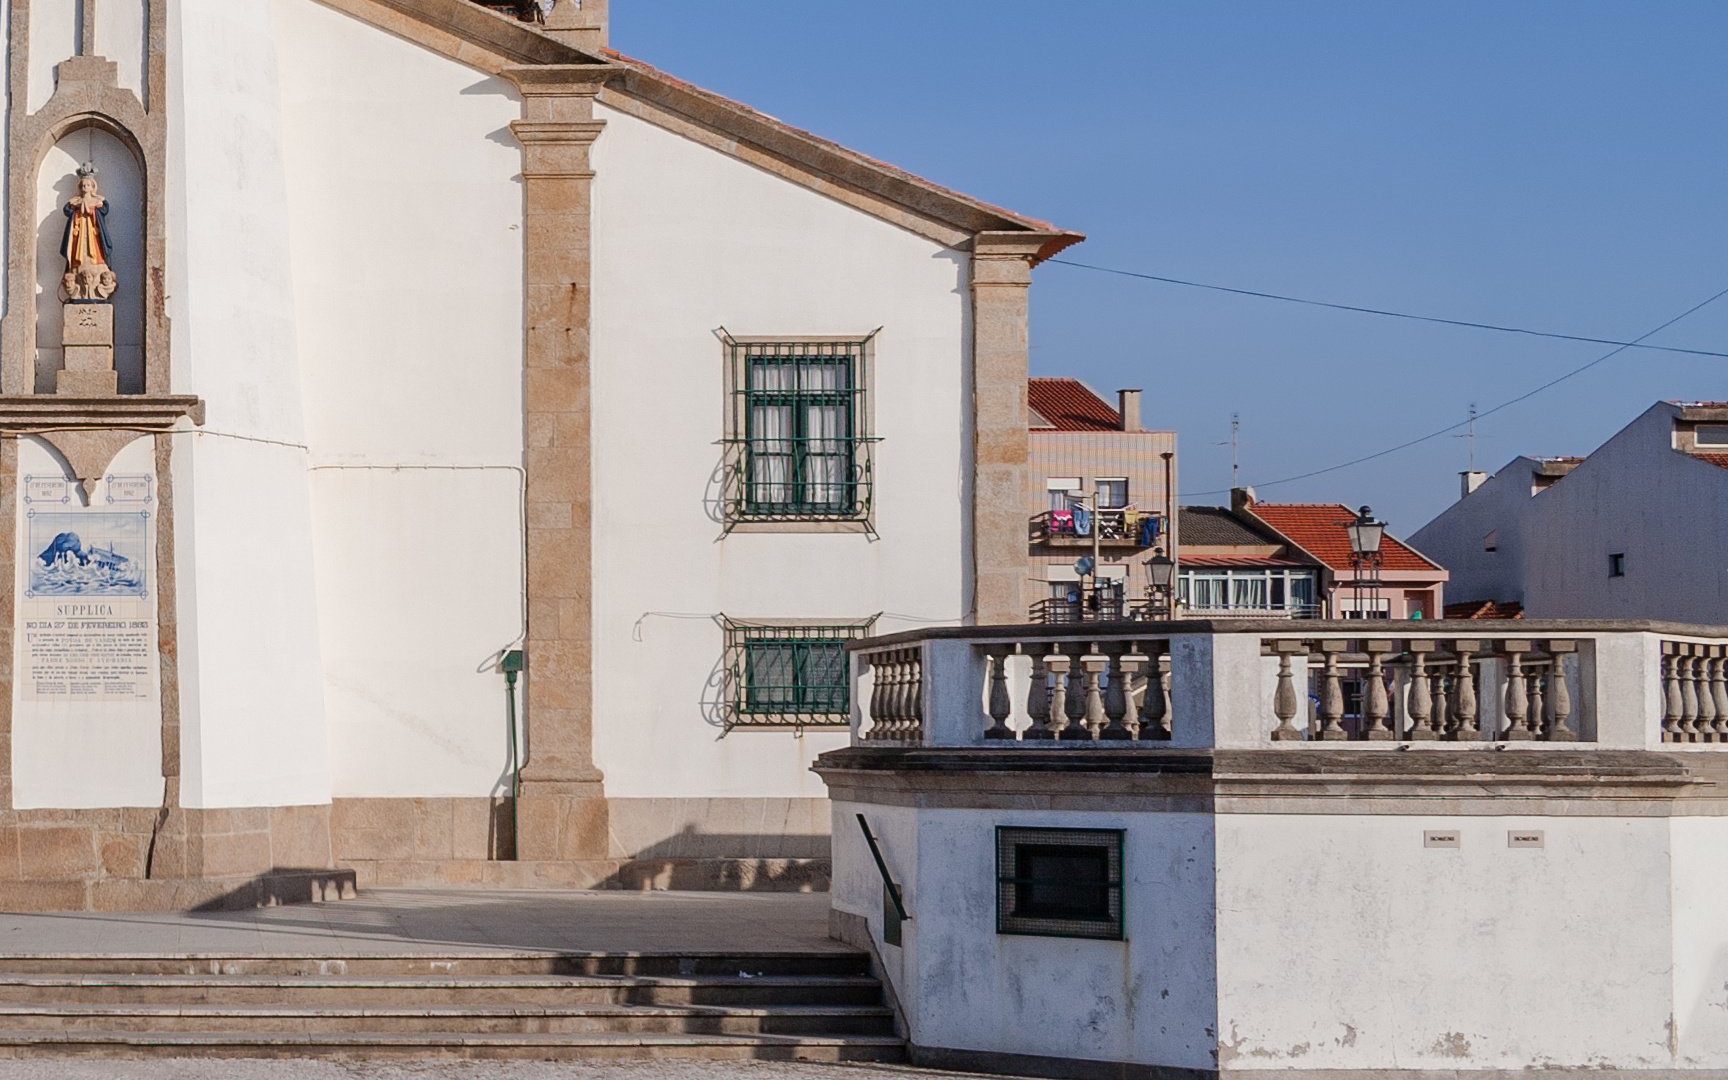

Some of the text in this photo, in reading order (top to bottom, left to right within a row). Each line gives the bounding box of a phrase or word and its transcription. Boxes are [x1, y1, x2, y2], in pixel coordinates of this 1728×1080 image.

[57, 604, 113, 616] SUPPLICA
[39, 621, 53, 629] DIA
[67, 621, 80, 629] DE
[81, 621, 127, 629] FEVEREIRO
